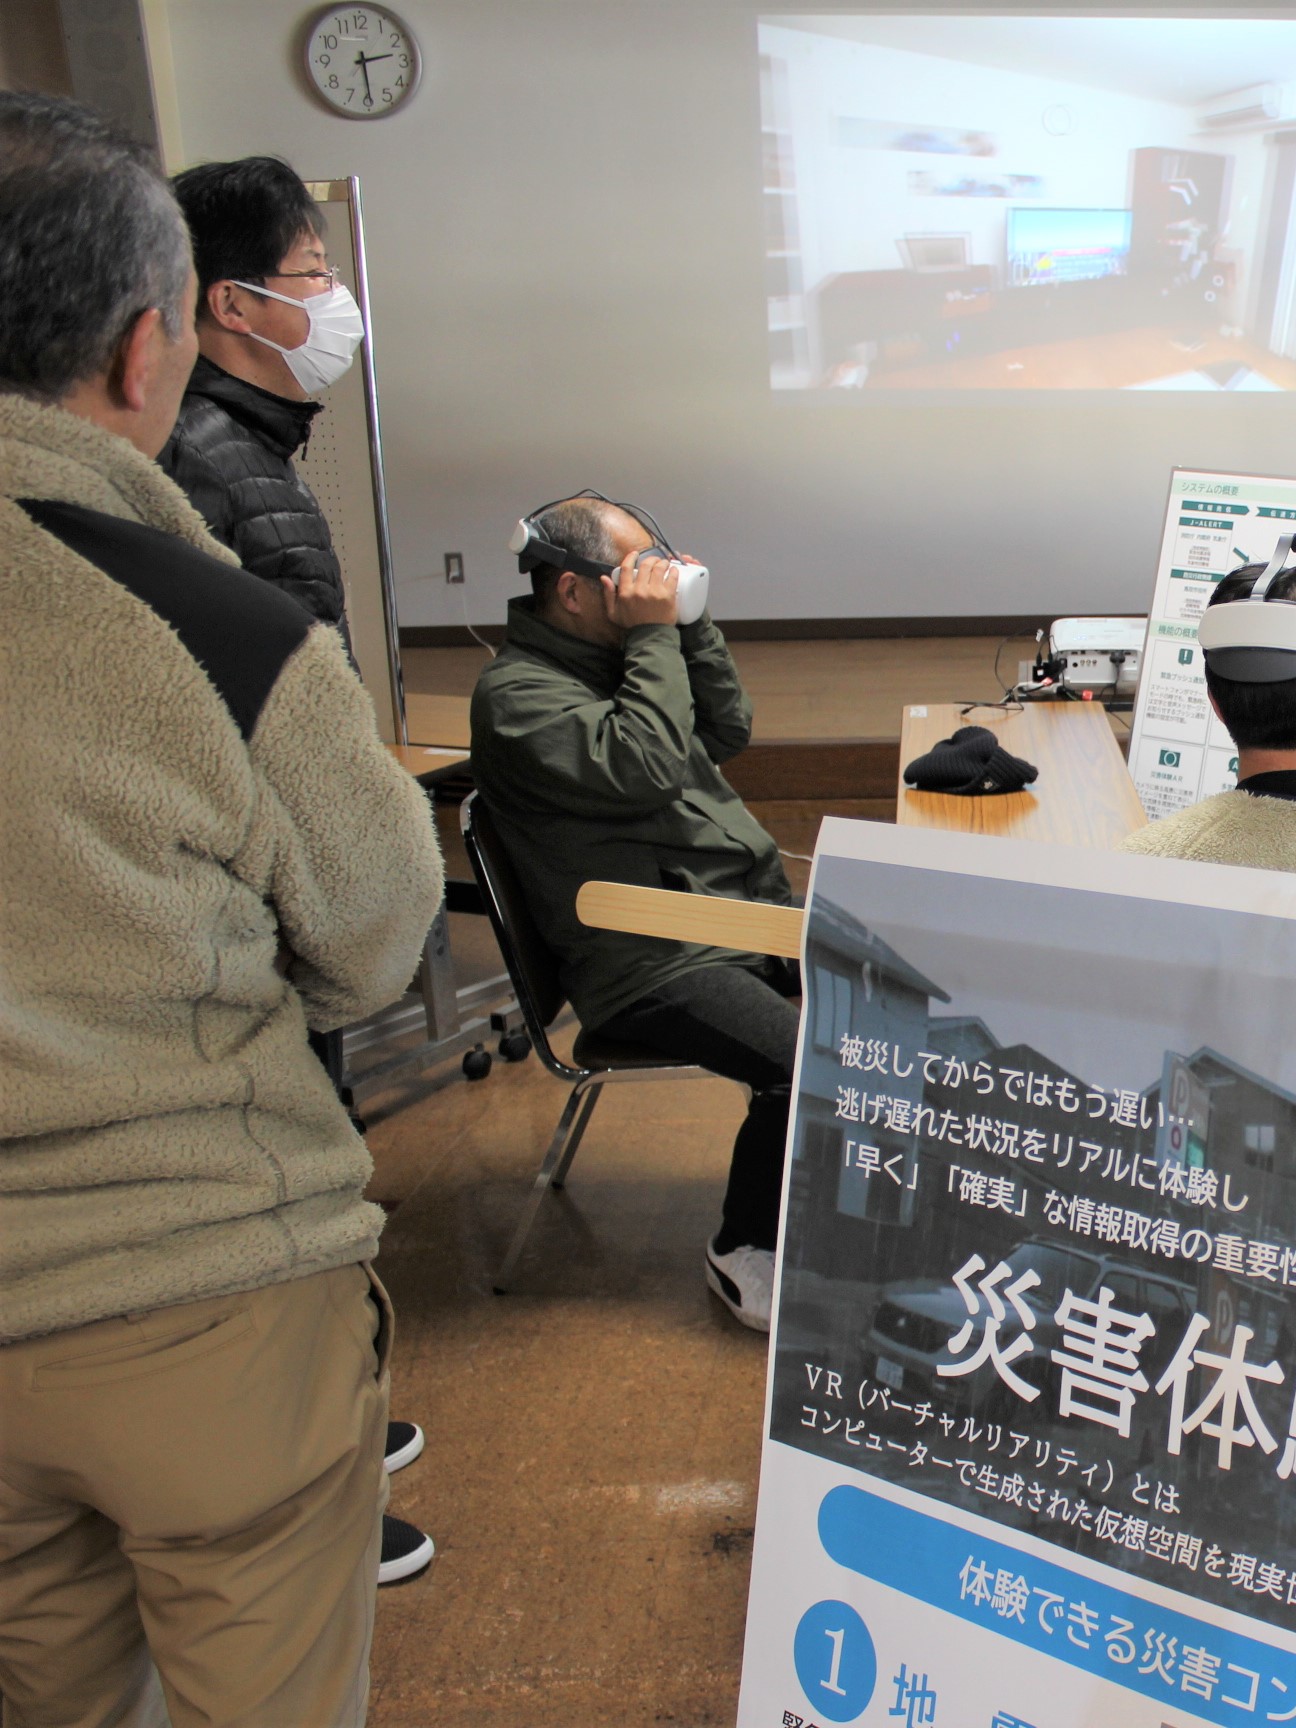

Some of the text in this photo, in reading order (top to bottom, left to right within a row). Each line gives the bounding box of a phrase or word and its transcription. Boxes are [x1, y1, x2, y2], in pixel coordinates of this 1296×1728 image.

[338, 19, 349, 34] 11
[353, 15, 368, 30] 12
[323, 34, 338, 50] 10
[390, 33, 400, 48] 2
[319, 54, 331, 69] 9
[398, 54, 409, 68] 3
[328, 74, 339, 89] 8
[395, 75, 404, 88] 4
[345, 88, 355, 103] 7
[382, 88, 393, 103] 5
[1181, 482, 1240, 497] システムの概要
[834, 1085, 1250, 1213] 逃げ遅れた状況をリアルに体験し
[820, 1628, 847, 1697] 1
